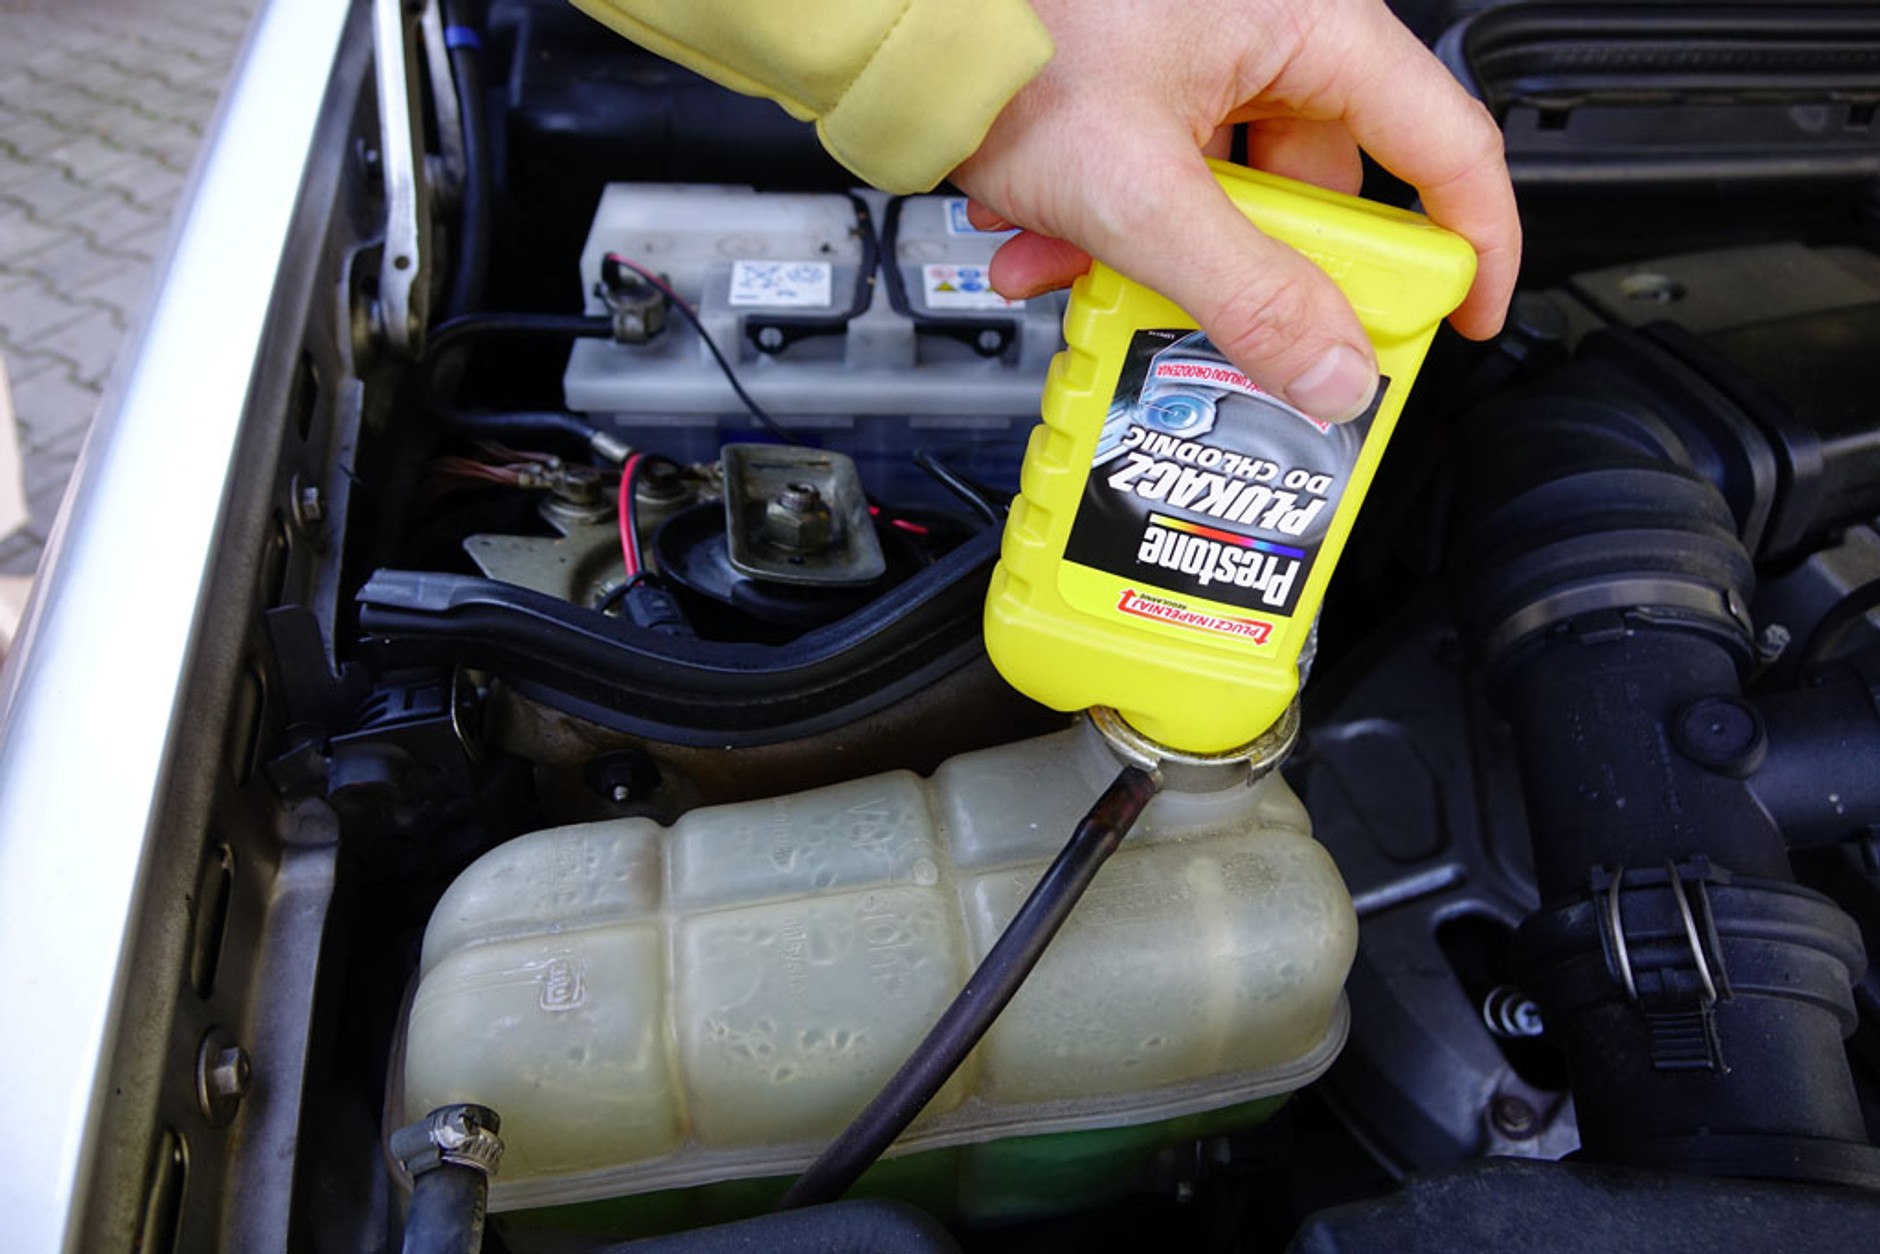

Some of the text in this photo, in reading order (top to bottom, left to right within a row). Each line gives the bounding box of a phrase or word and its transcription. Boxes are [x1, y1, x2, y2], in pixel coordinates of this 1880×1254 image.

[1107, 450, 1328, 536] PŁUKACZ
[1123, 426, 1334, 495] DO CHŁODNIC
[1138, 527, 1301, 607] Prestone
[1215, 619, 1259, 636] PŁUCZ
